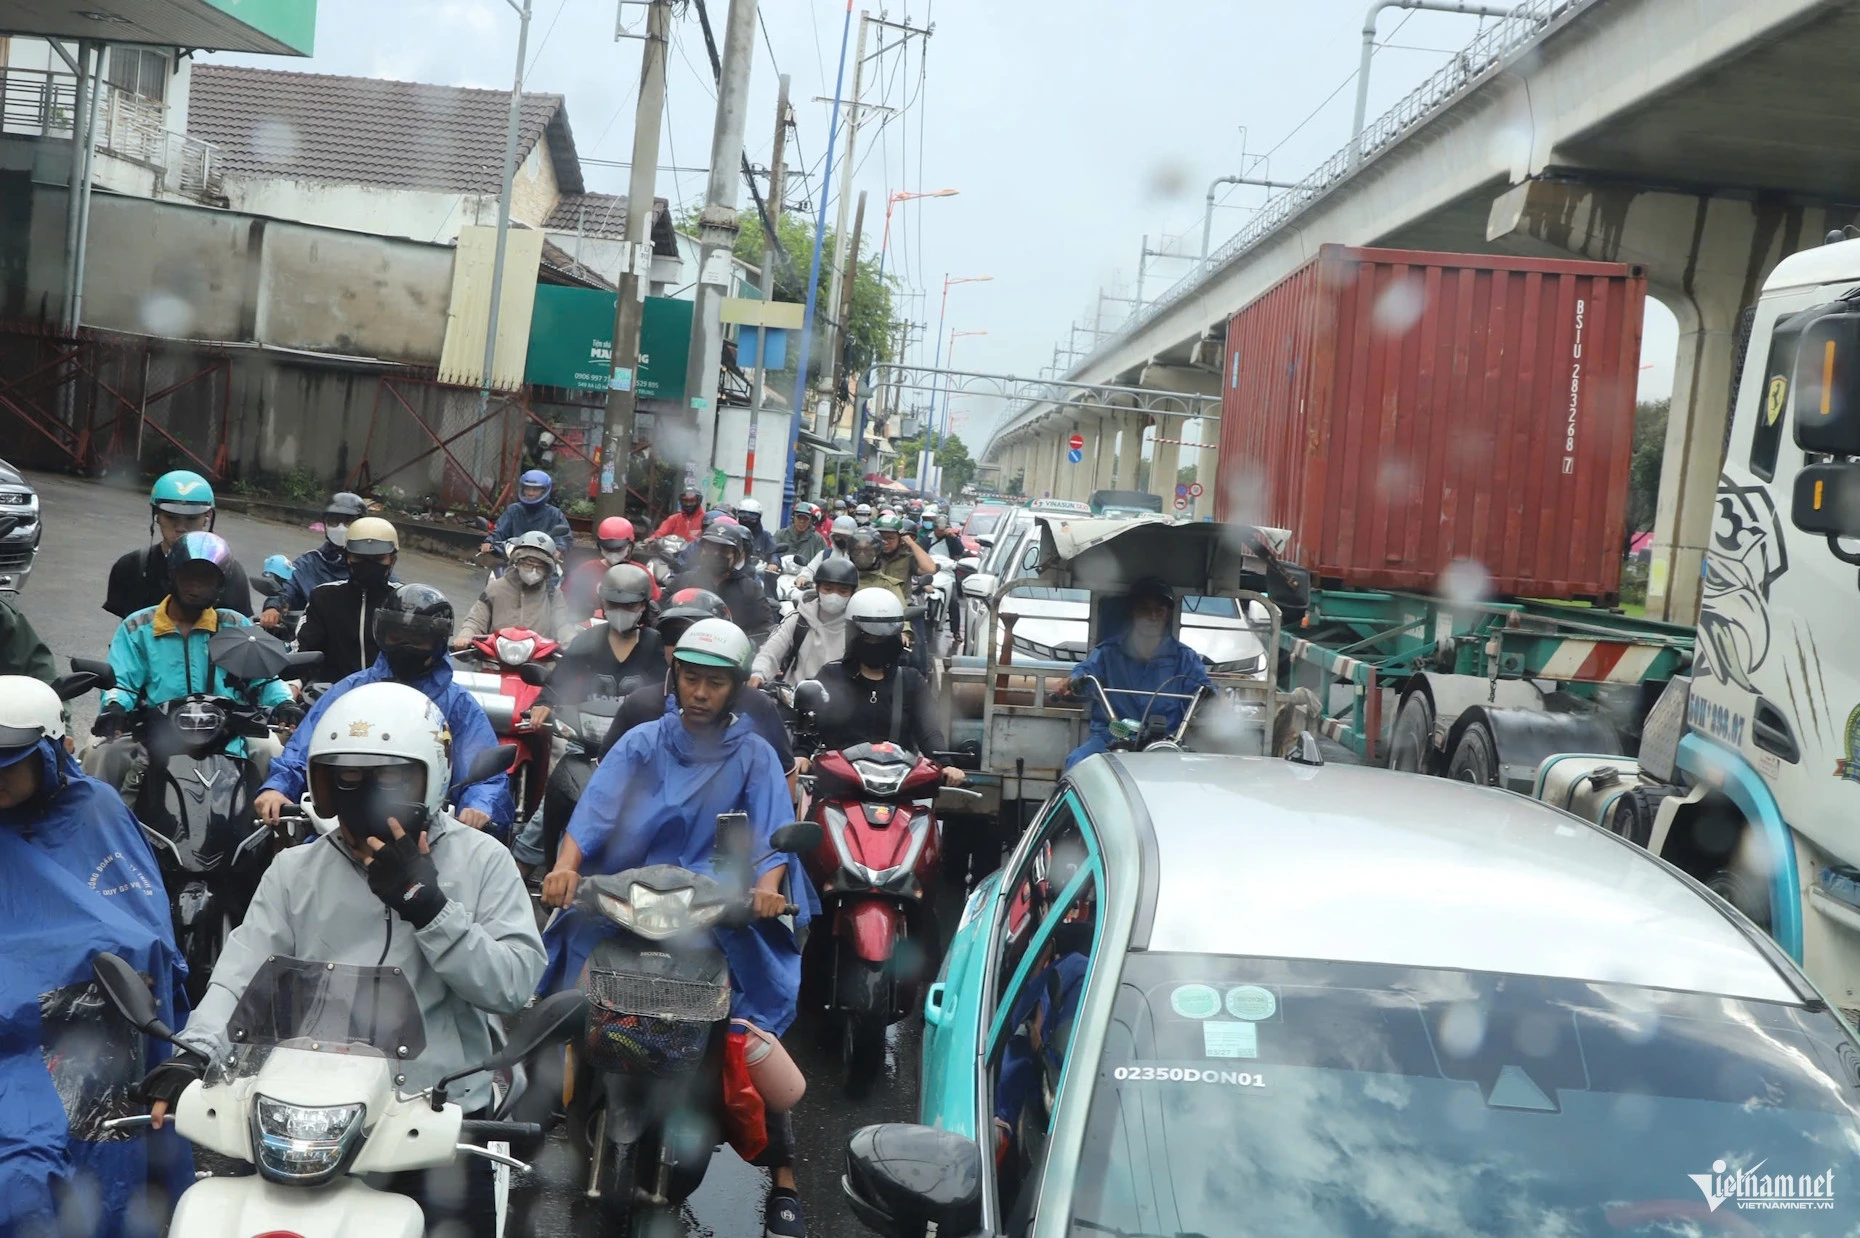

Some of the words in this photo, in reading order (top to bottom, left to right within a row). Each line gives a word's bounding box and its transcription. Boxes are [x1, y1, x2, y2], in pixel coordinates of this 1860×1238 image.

[1573, 299, 1585, 359] BSIU
[1565, 363, 1580, 452] 283268
[1045, 500, 1075, 509] VINASUN
[639, 951, 672, 959] HONDA
[1113, 1066, 1266, 1088] 02350DON01
